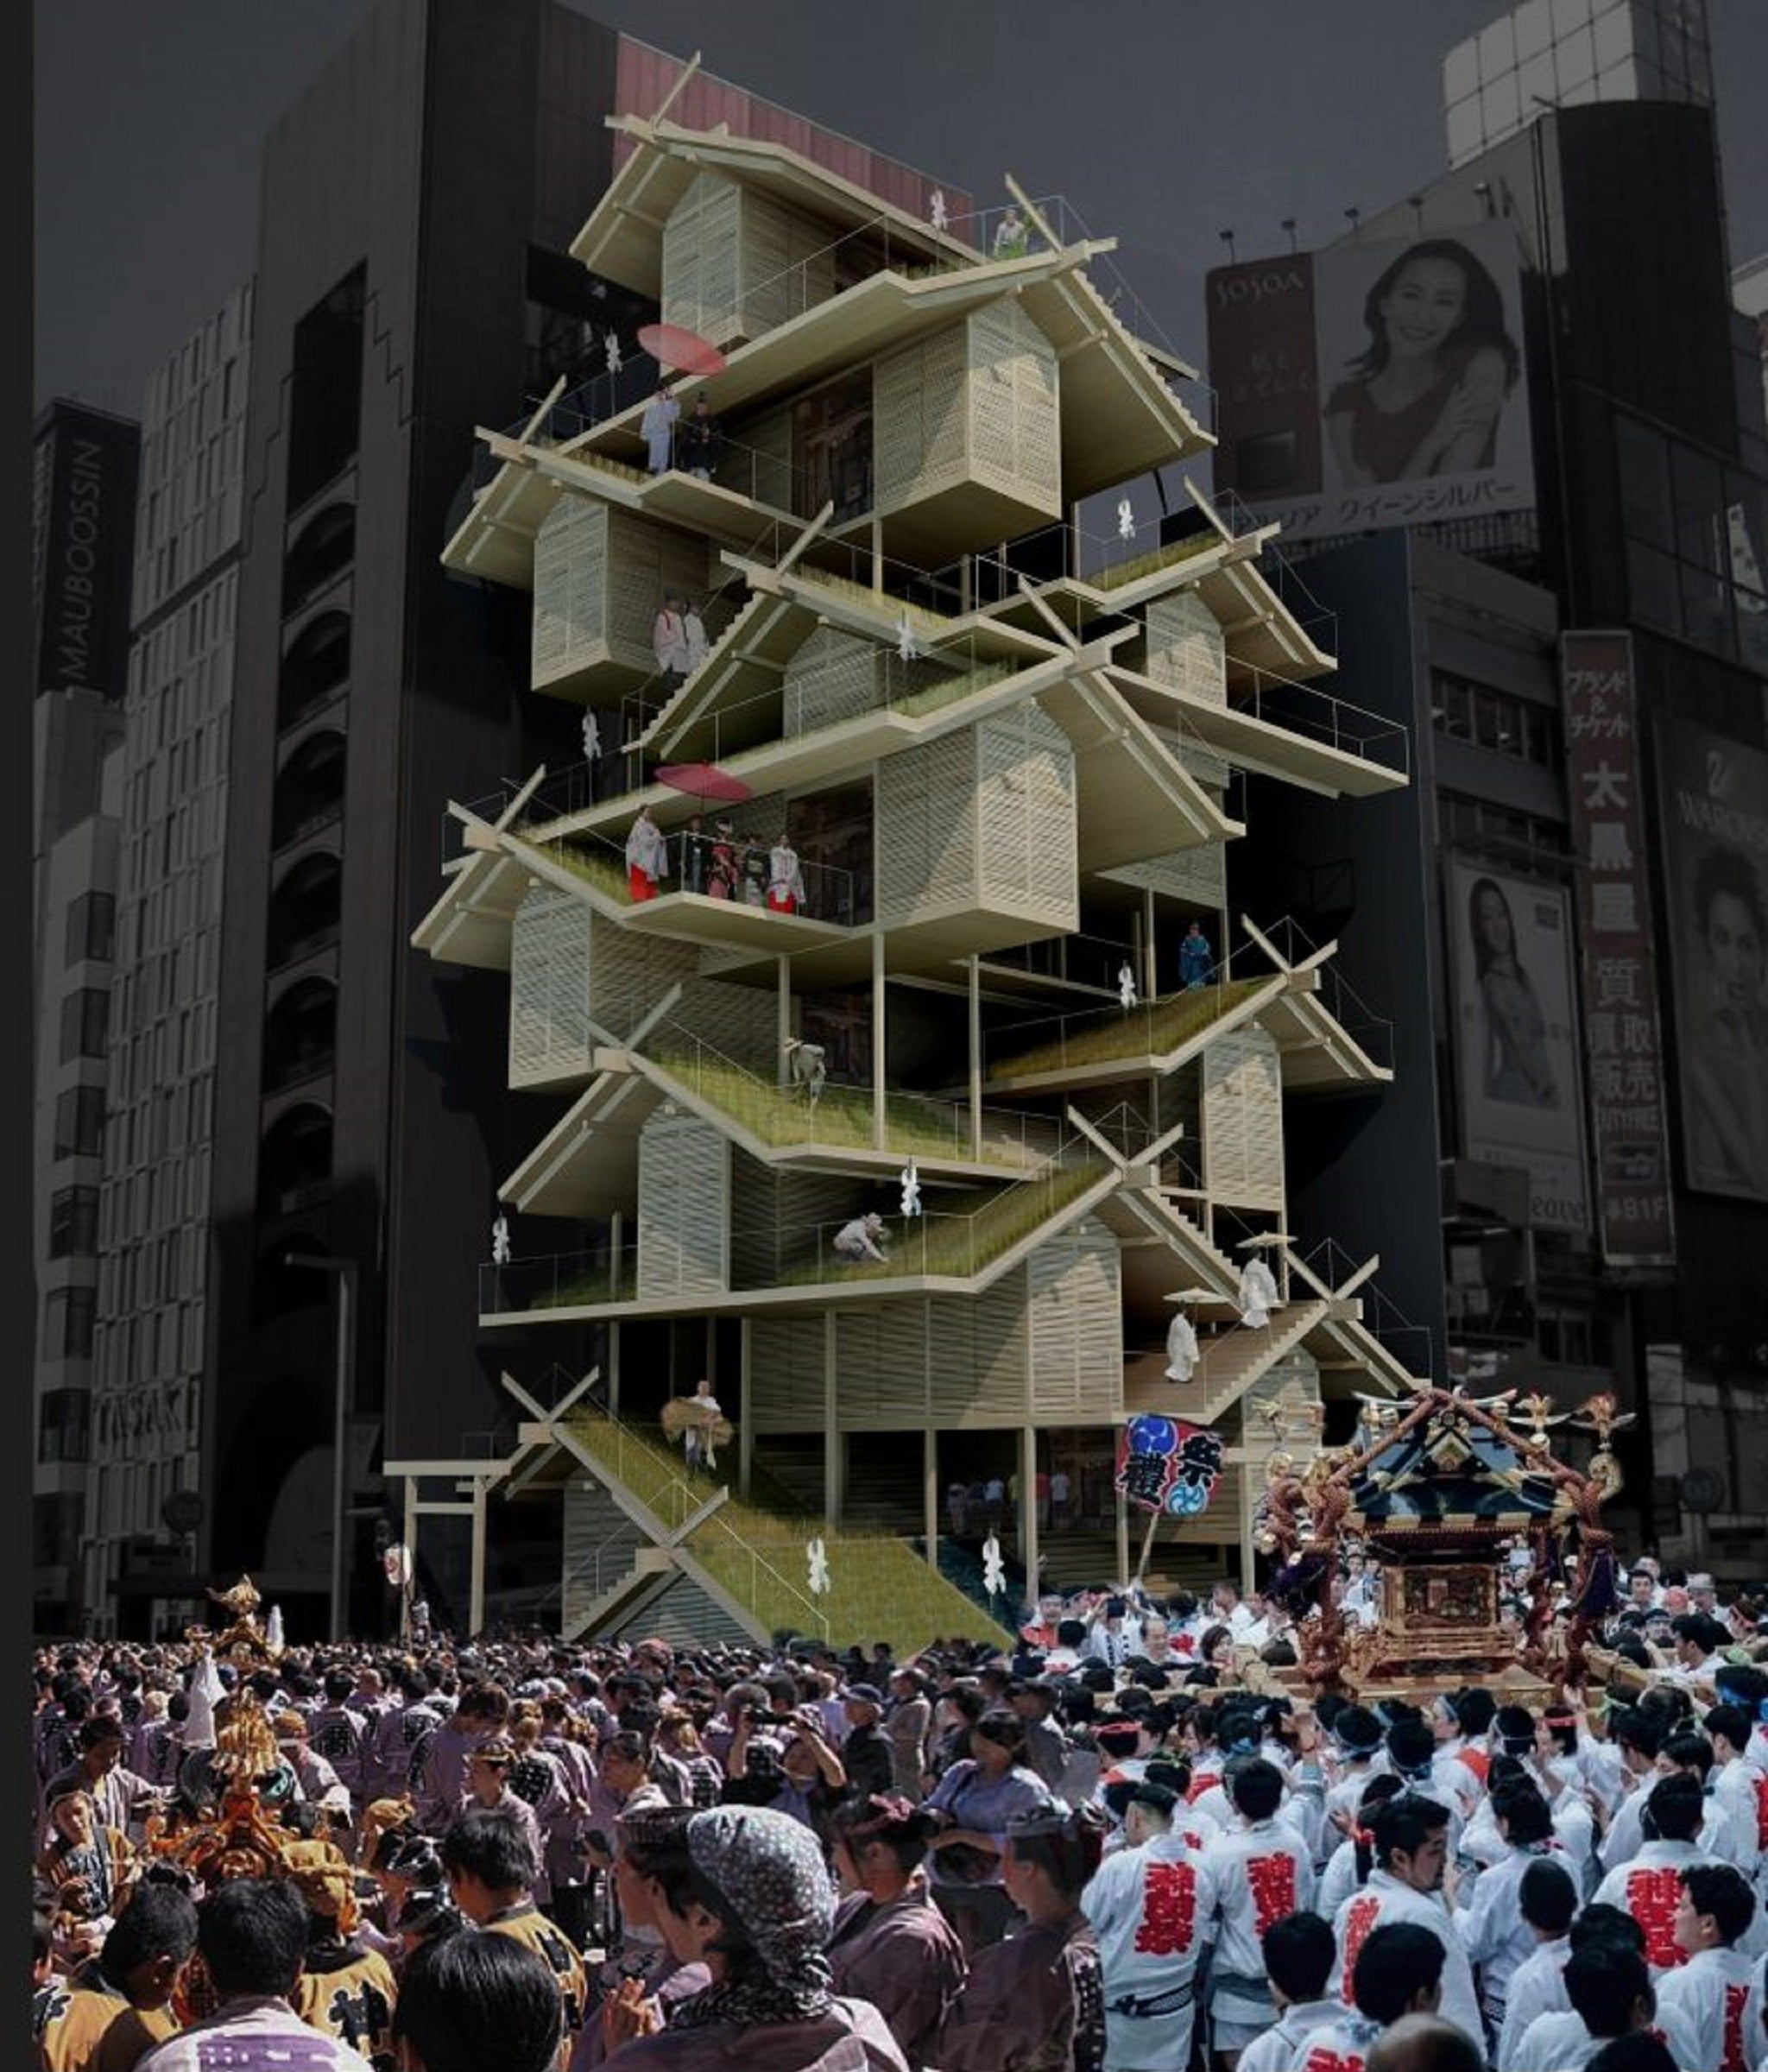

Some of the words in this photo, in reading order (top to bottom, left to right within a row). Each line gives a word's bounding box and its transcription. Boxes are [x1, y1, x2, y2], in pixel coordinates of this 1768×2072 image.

[1341, 478, 1517, 524] クイーンシルバー
